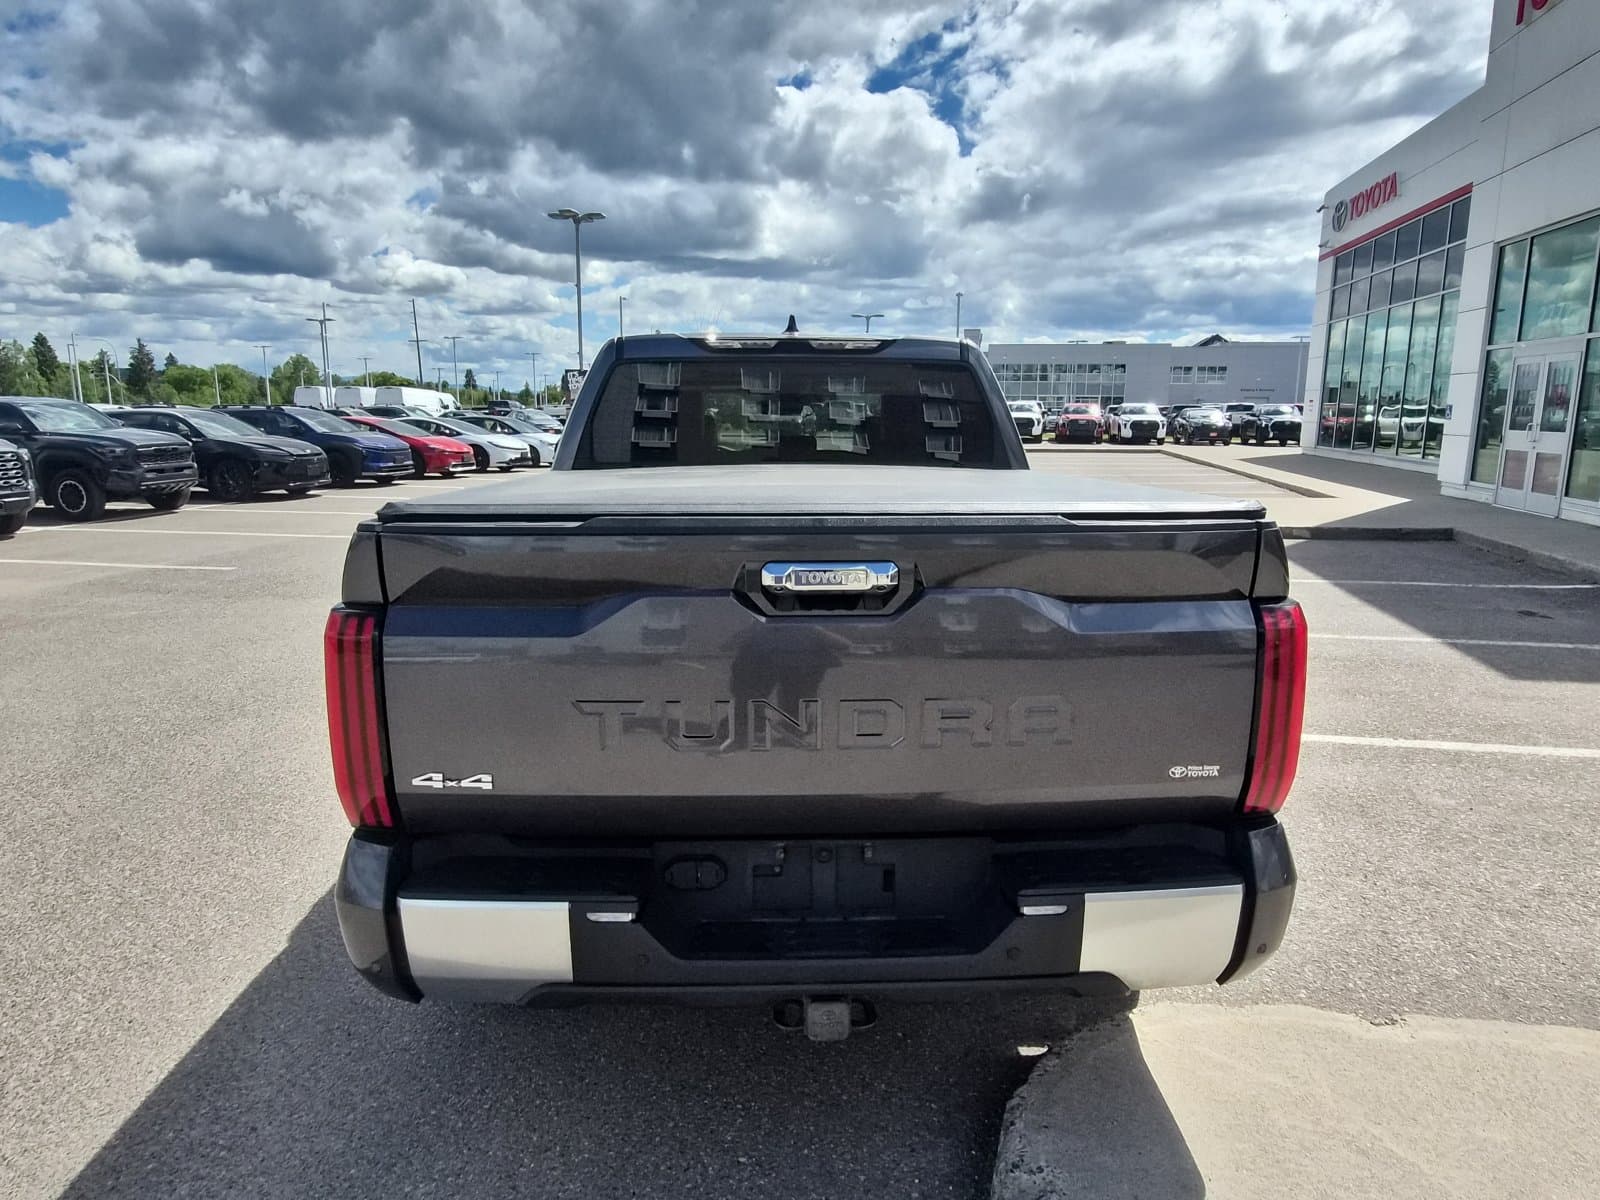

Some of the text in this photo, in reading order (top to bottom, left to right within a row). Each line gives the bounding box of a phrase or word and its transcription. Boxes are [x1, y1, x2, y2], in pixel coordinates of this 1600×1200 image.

[1349, 171, 1398, 221] TOYOTA
[799, 571, 862, 585] TOYOTA
[572, 698, 1075, 752] TUNDRA
[1187, 769, 1219, 777] TOYOTA
